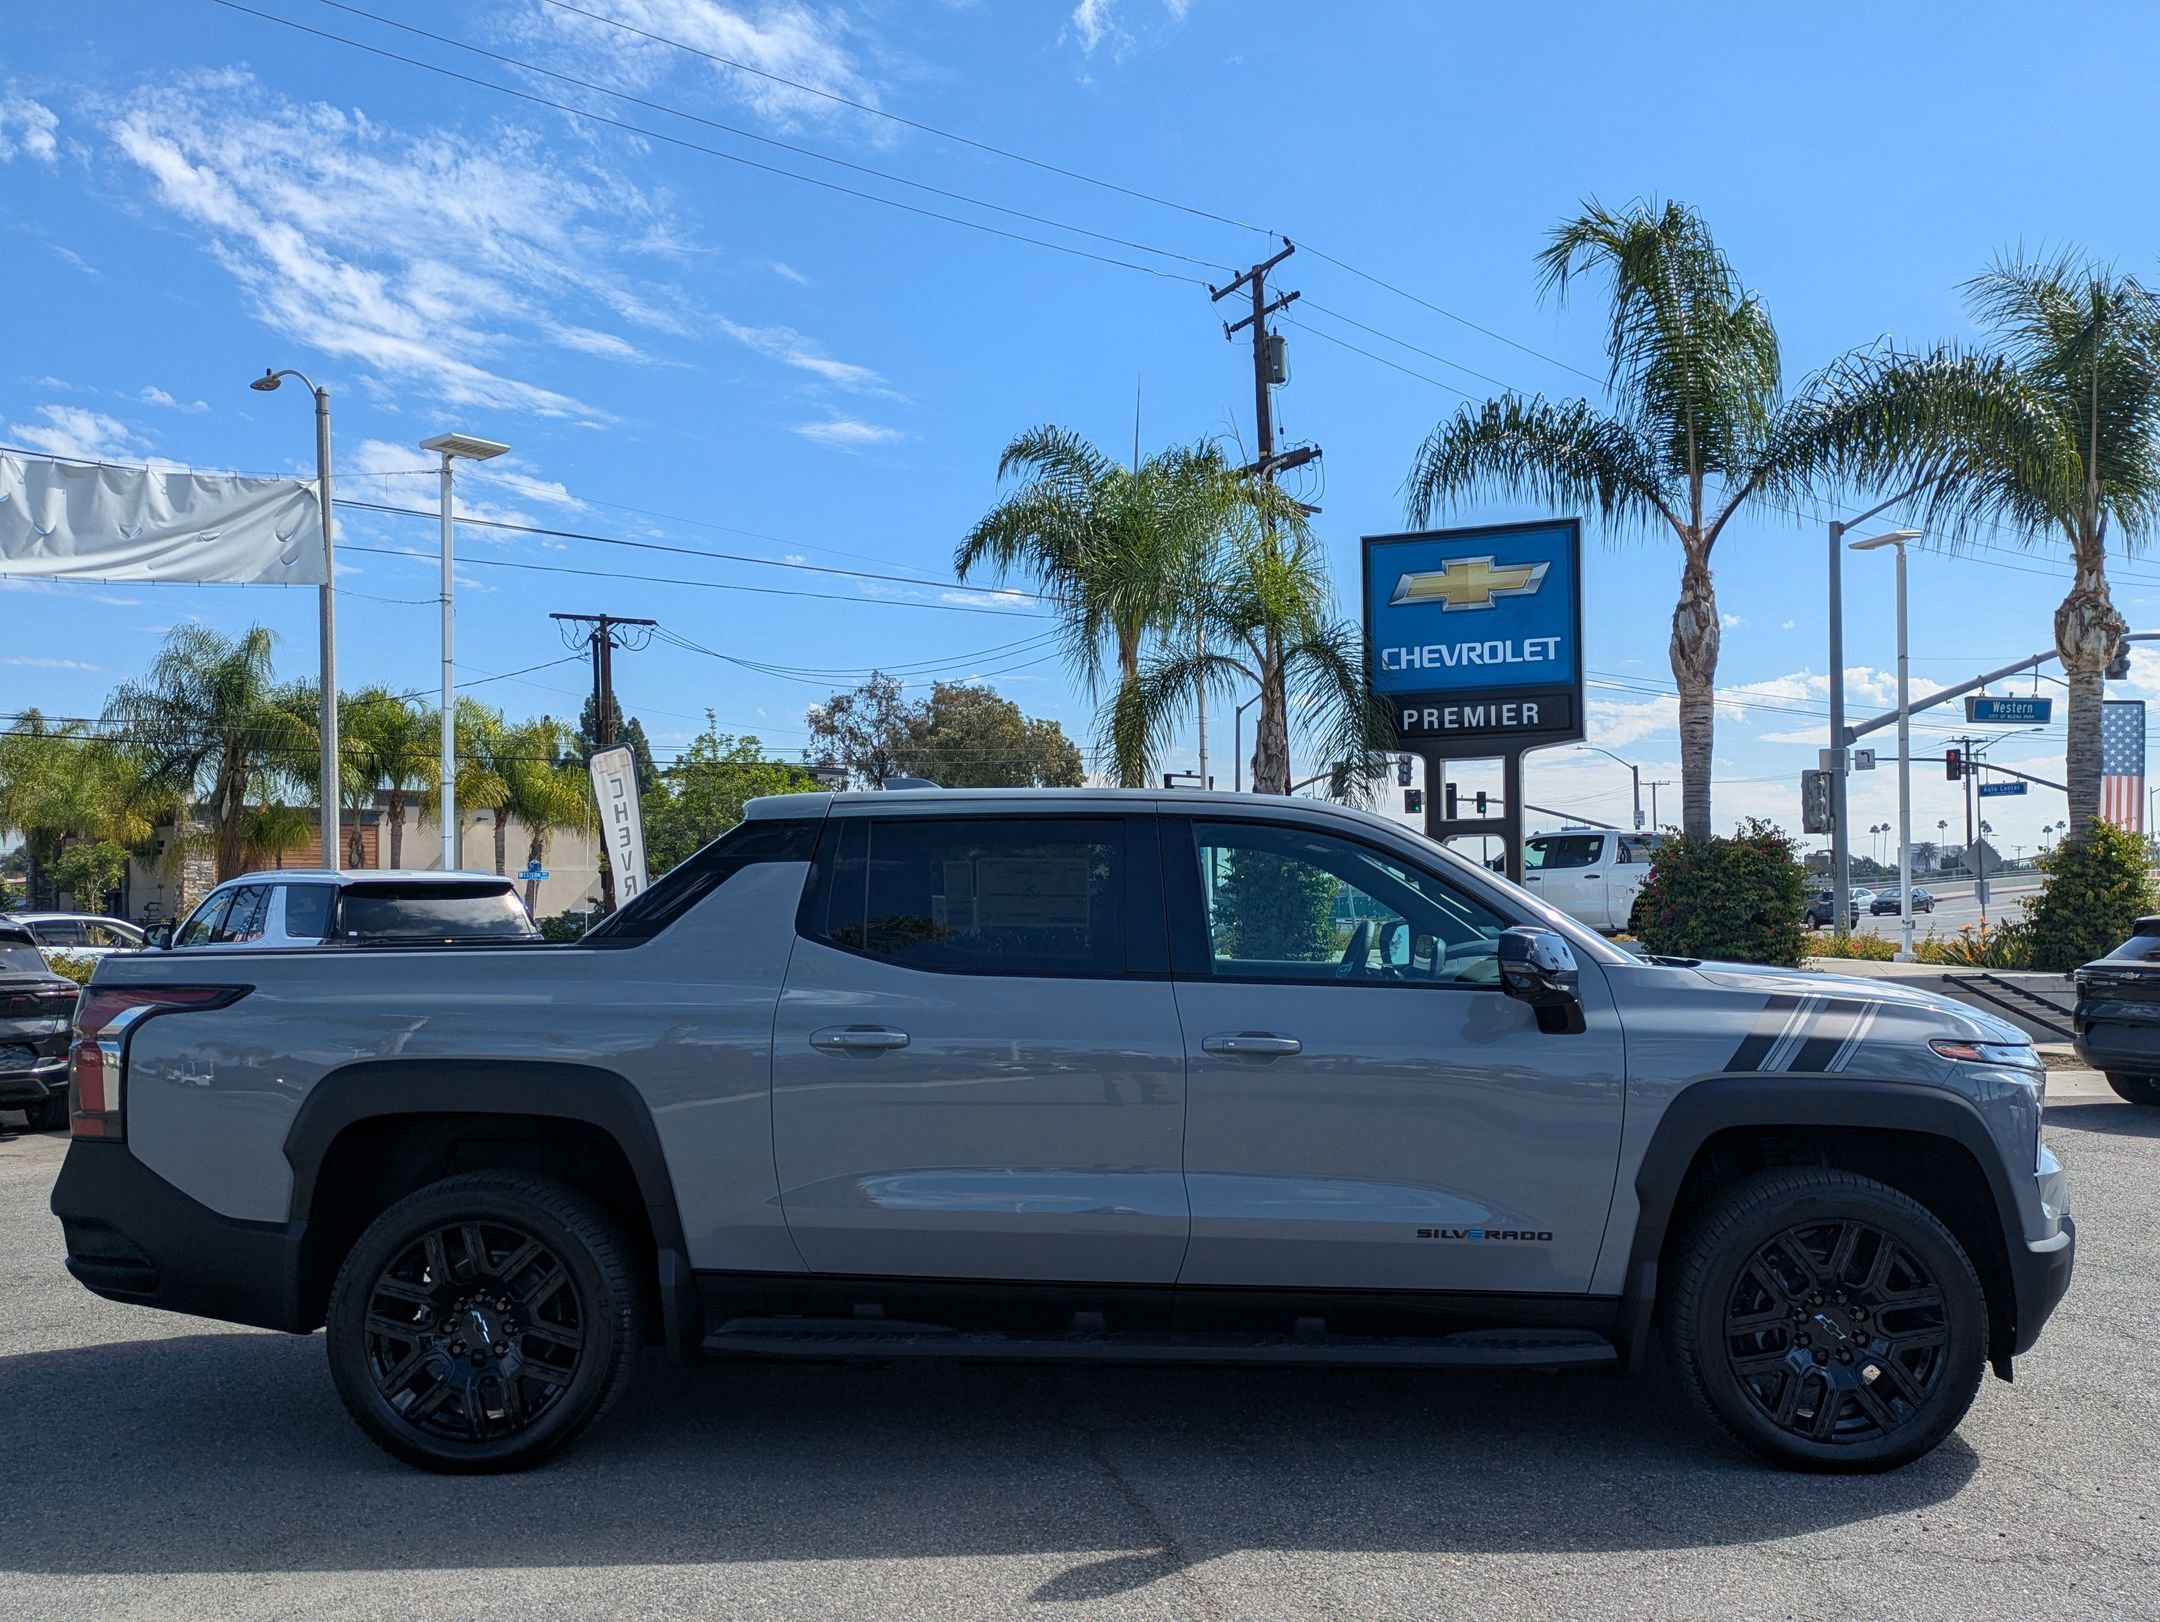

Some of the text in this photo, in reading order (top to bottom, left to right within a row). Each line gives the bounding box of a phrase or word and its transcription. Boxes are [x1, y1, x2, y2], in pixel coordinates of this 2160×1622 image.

[1381, 636, 1561, 671] CHEVROLET
[1403, 702, 1539, 731] PREMIER
[1993, 701, 2033, 713] Western
[1416, 1228, 1553, 1241] SILVERADO
